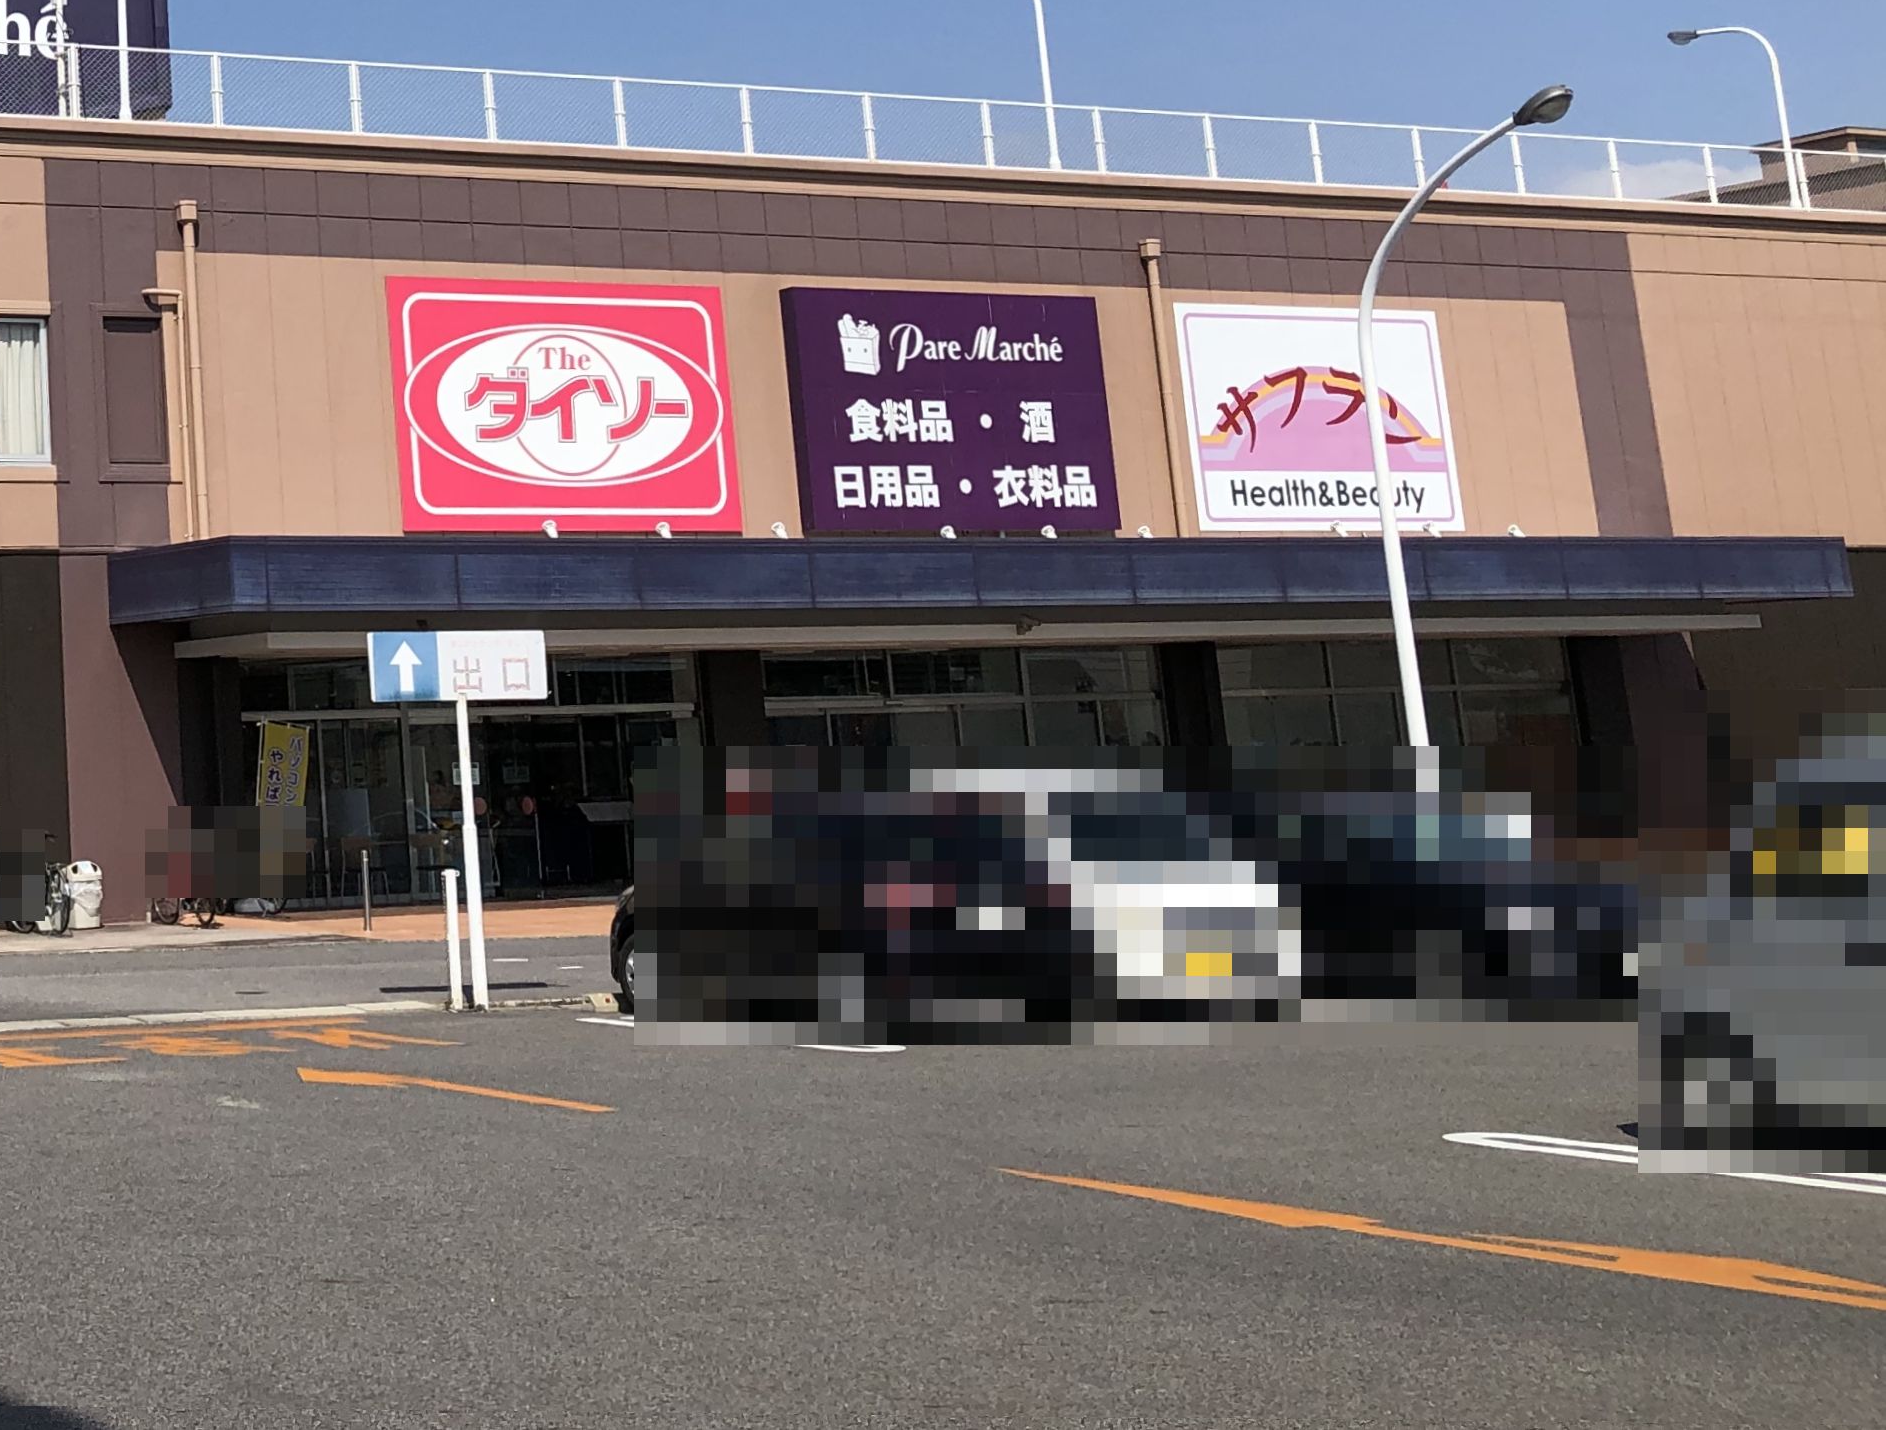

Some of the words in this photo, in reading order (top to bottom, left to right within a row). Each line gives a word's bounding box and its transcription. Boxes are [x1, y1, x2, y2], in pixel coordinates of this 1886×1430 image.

[537, 346, 592, 371] The
[888, 323, 962, 373] Pare
[964, 326, 1064, 363] Marché
[464, 366, 689, 444] ダイソー
[452, 655, 532, 693] 出口
[265, 748, 285, 806] やれば
